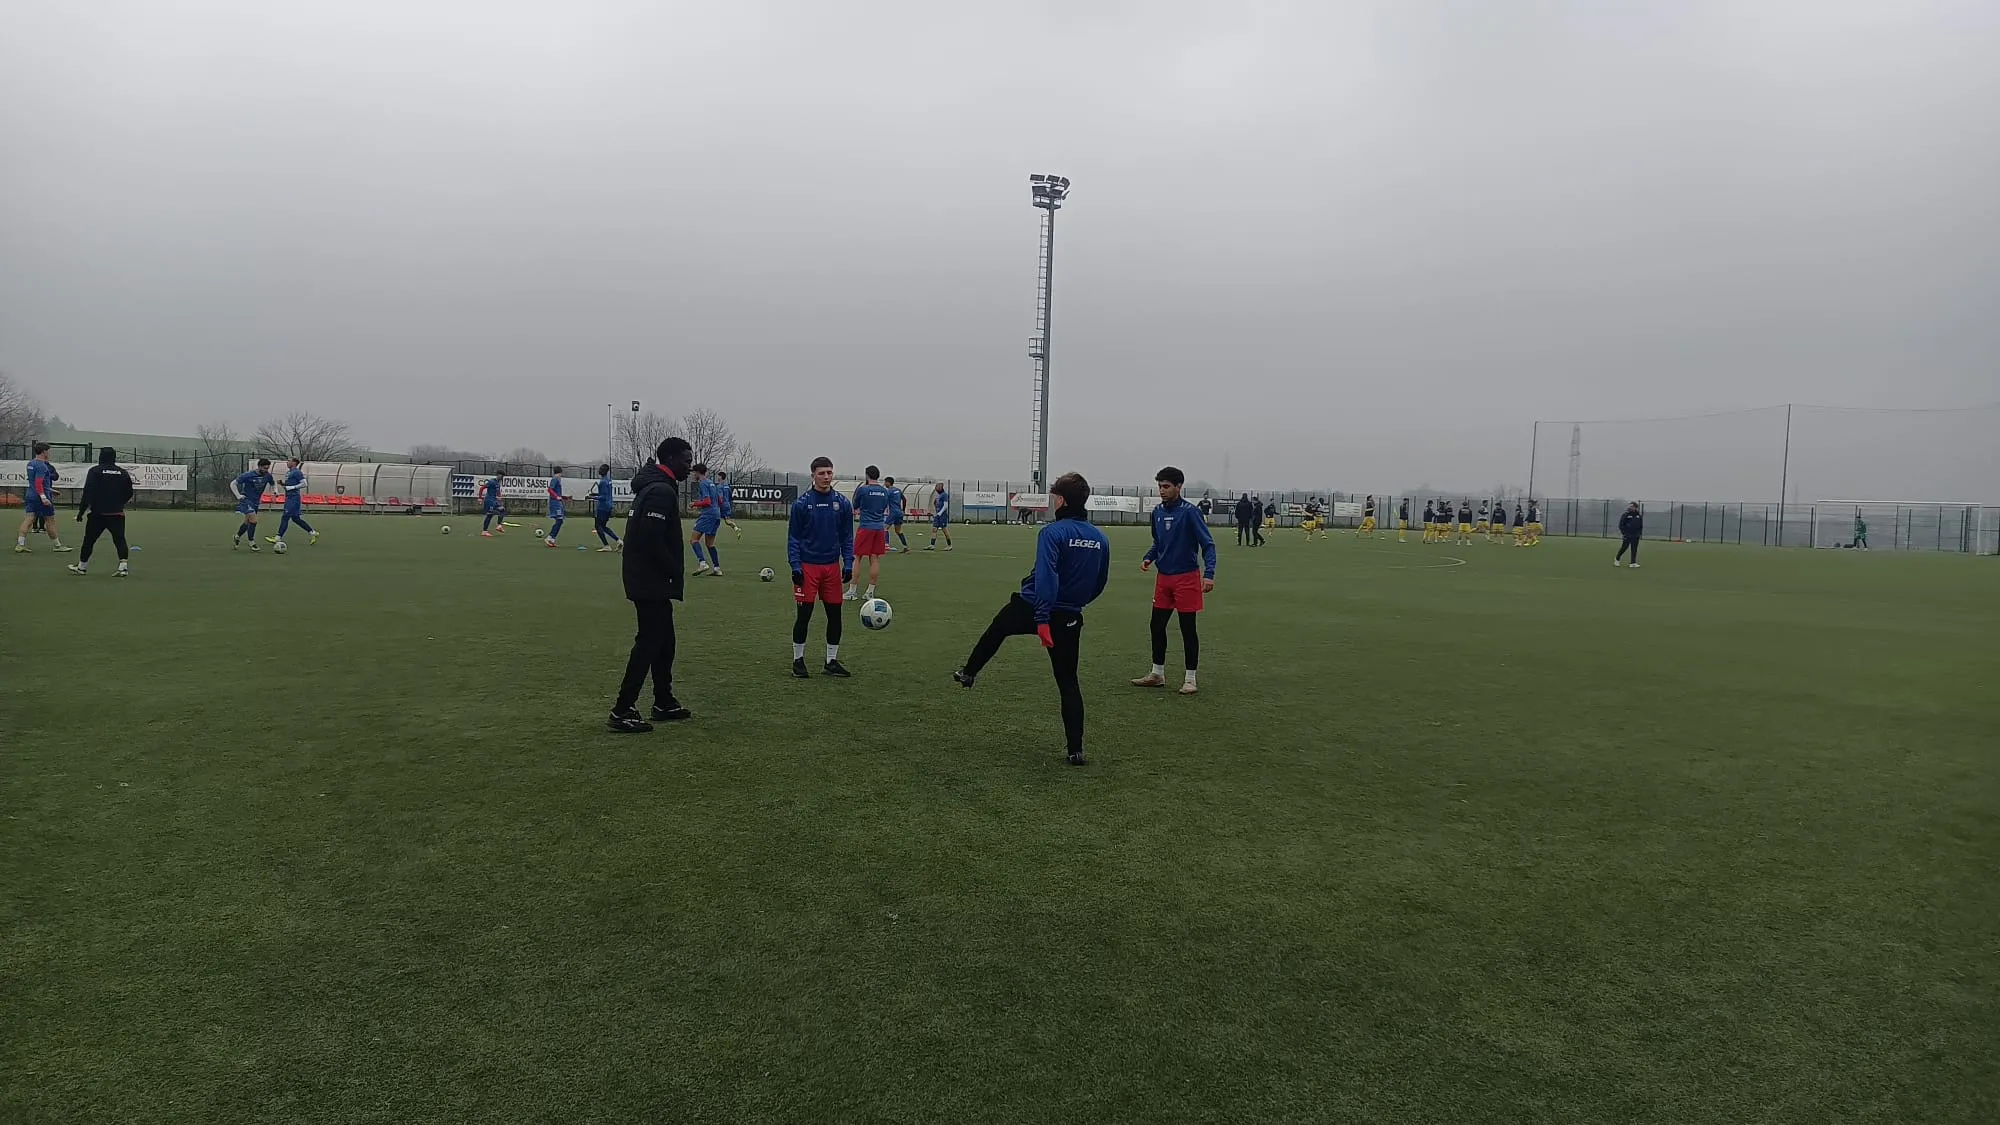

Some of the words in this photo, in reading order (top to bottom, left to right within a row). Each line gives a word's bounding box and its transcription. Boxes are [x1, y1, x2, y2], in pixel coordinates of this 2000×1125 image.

[731, 488, 748, 498] ATI
[751, 488, 782, 499] AUTO
[1069, 538, 1101, 550] LEGEA
